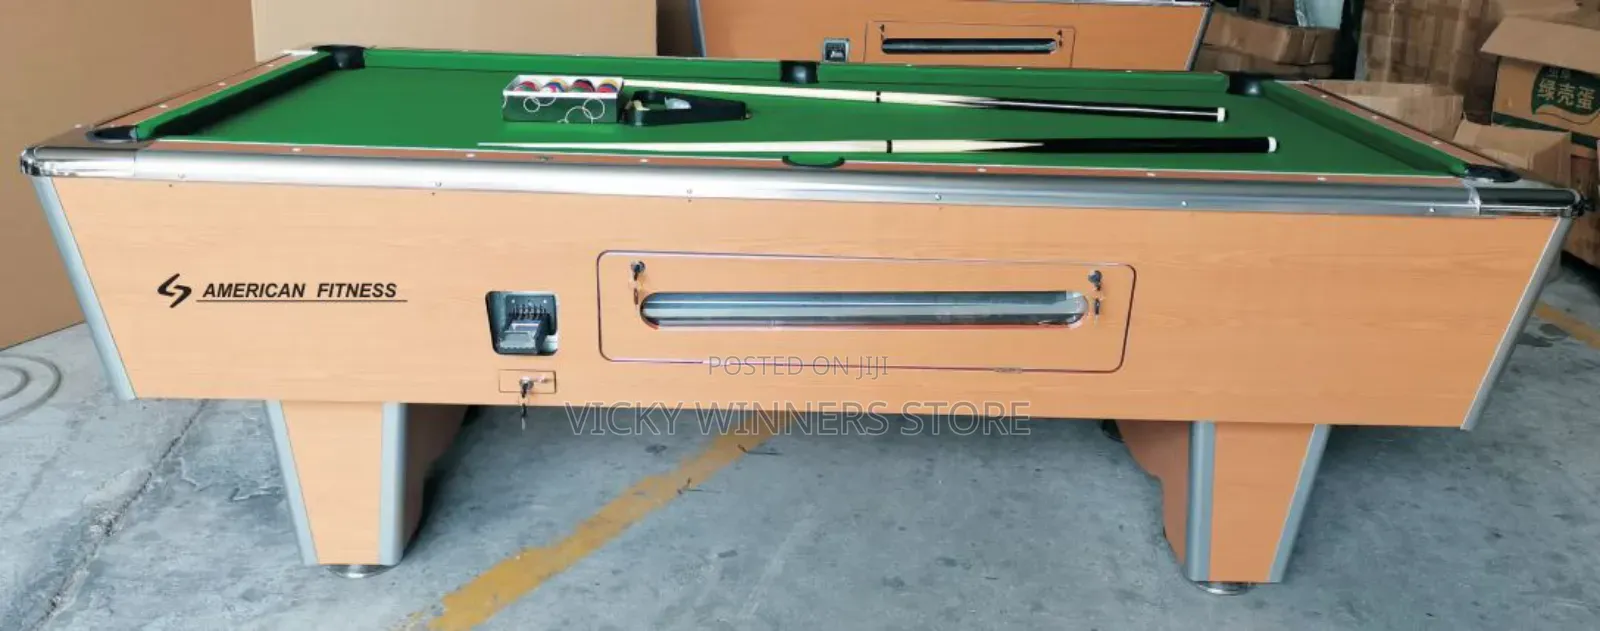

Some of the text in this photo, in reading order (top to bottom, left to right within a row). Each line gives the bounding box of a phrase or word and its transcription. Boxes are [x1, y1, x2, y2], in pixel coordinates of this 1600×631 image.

[1537, 78, 1595, 110] 绿壳蛋
[202, 282, 398, 298] AMERICAN FITNESS
